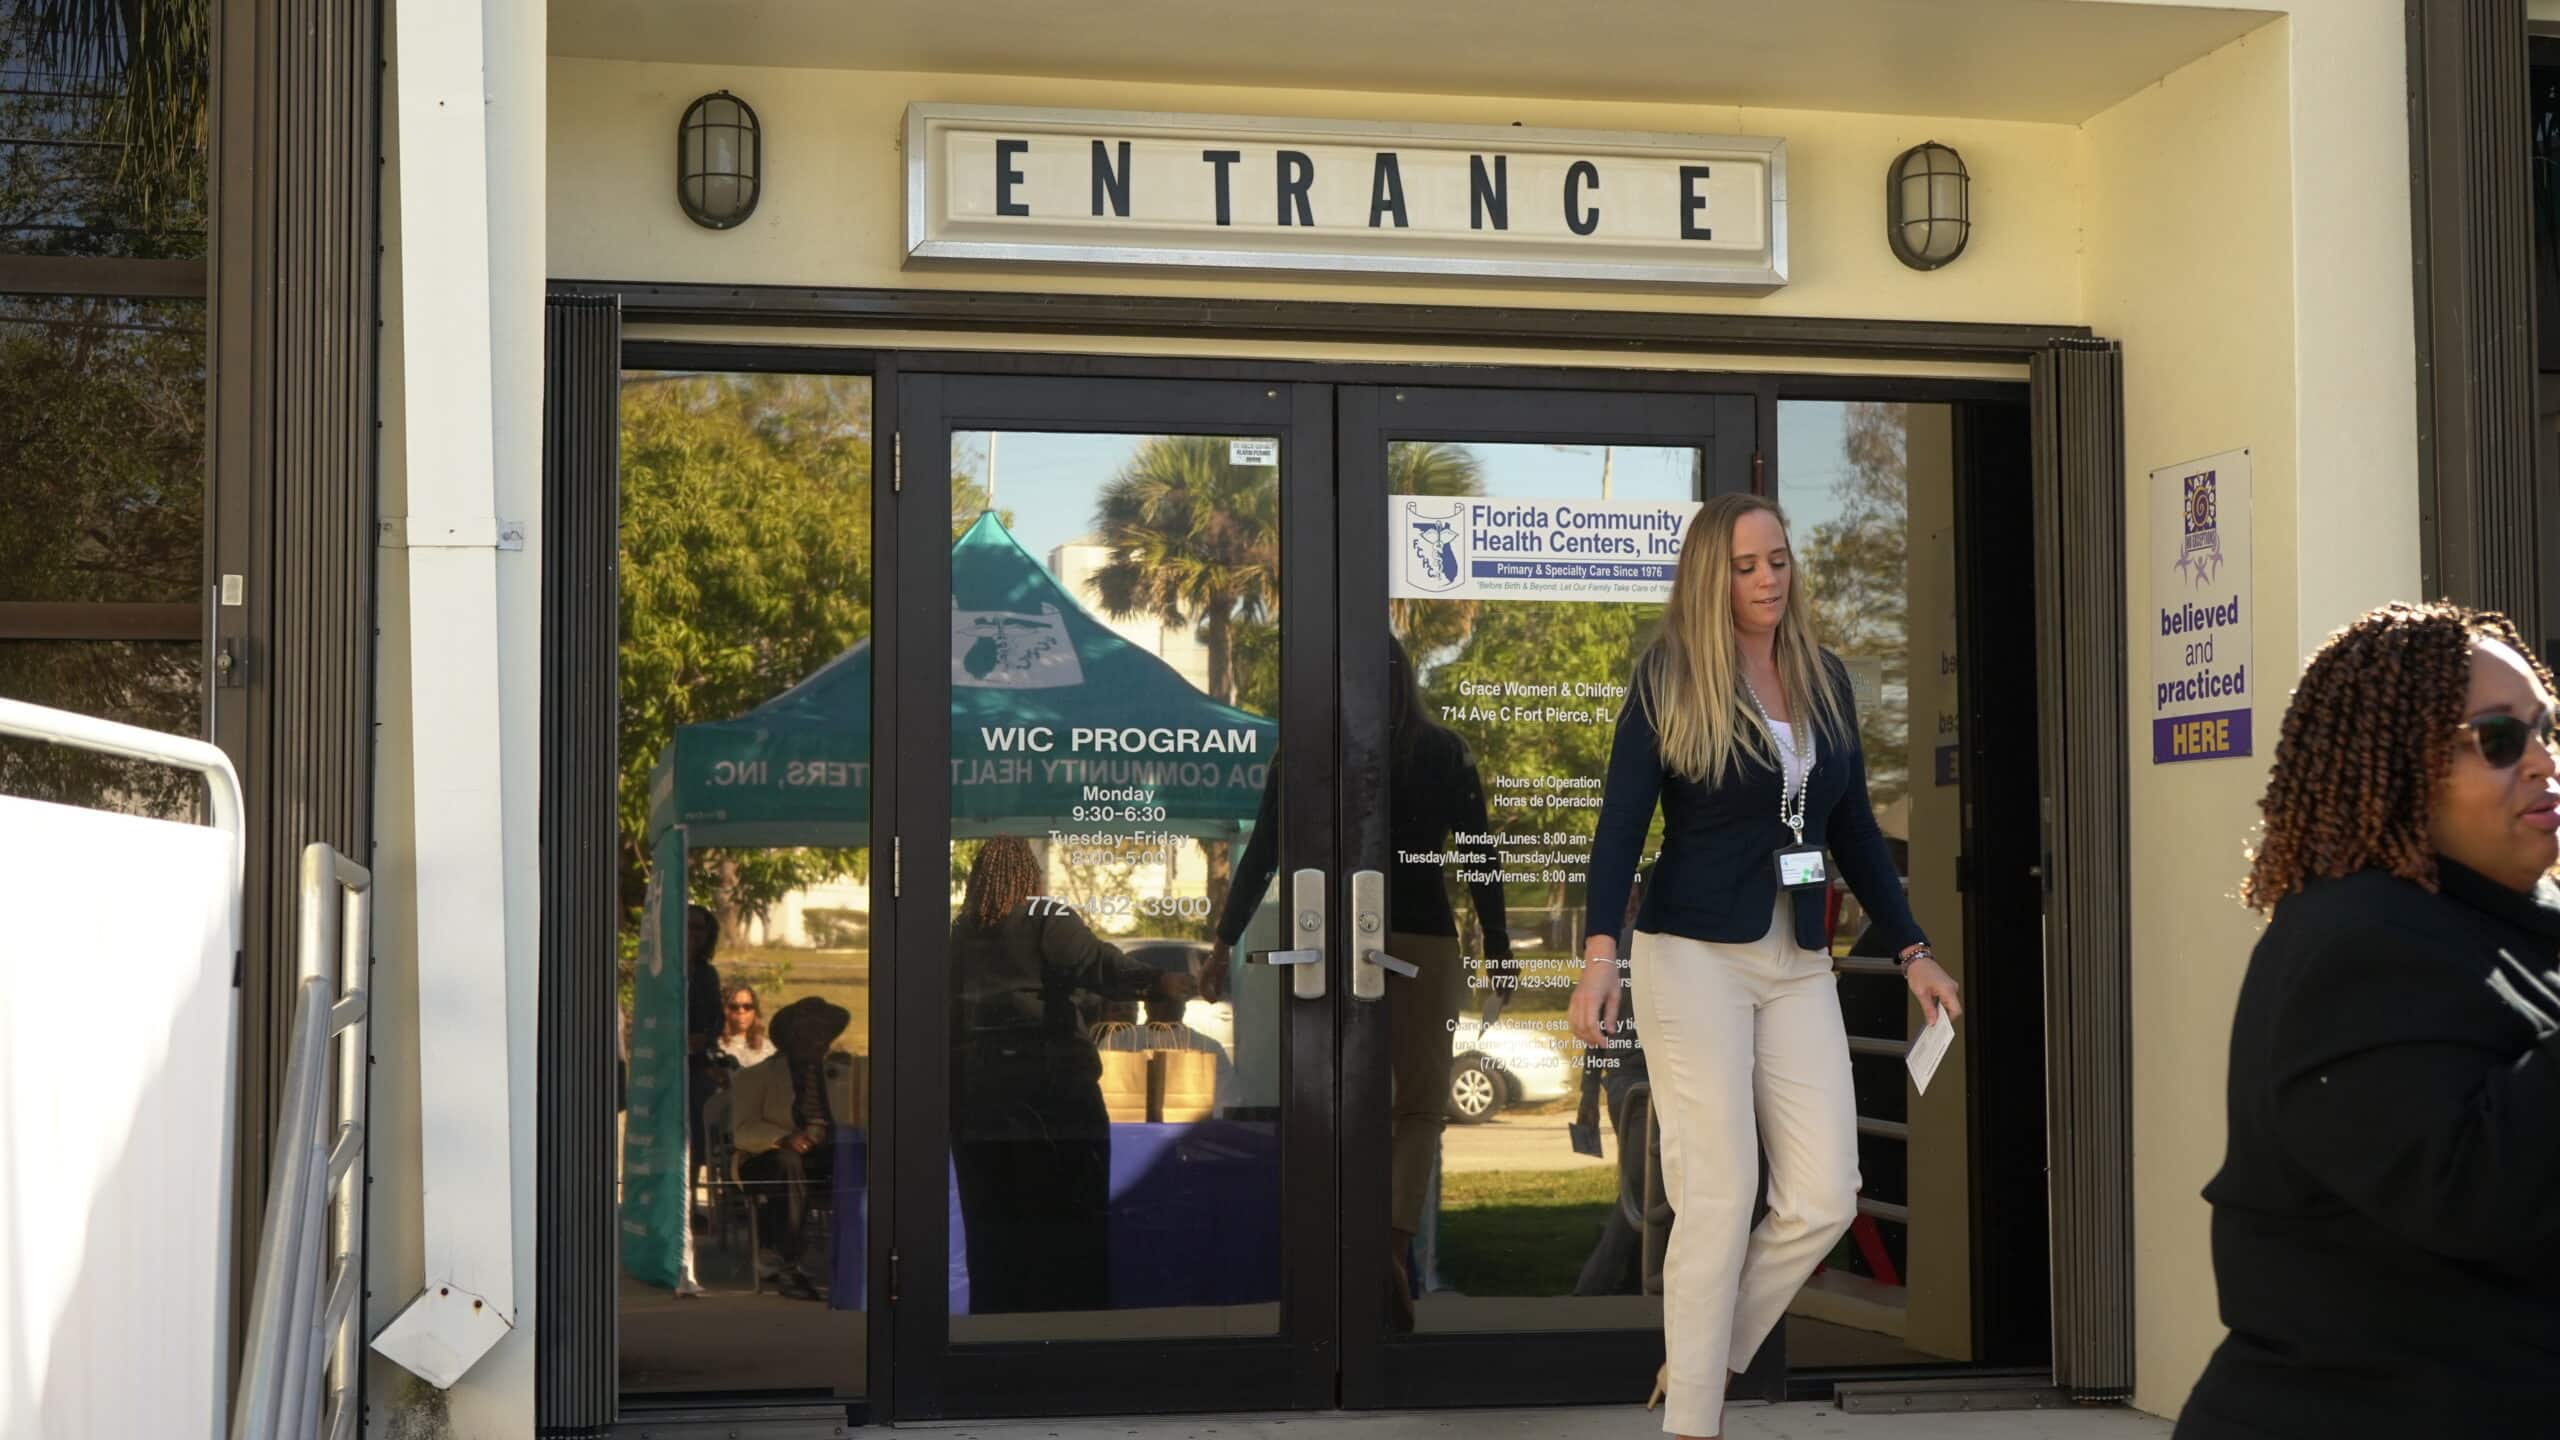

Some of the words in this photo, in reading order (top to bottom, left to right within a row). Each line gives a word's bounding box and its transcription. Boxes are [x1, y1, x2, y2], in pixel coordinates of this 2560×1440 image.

[996, 139, 1712, 241] ENTRANCE
[1472, 505, 1548, 528] Florida
[1556, 507, 1683, 537] Community
[1472, 529, 1542, 552] Health
[1550, 530, 1641, 557] Centers,
[1648, 533, 1680, 554] Inc
[1497, 563, 1533, 577] Primary
[1535, 564, 1542, 575] &
[1545, 564, 1587, 578] Specialty
[1589, 565, 1611, 577] Care
[1613, 565, 1638, 577] Since
[1641, 566, 1662, 577] 1976
[2161, 595, 2239, 636] believed
[2185, 633, 2213, 666] and
[1460, 681, 1500, 696] Grace
[1504, 682, 1557, 697] Women
[1561, 682, 1571, 697] &
[2158, 664, 2244, 711] practiced
[1441, 706, 1466, 721] 714
[1469, 706, 1496, 721] Ave
[1500, 707, 1511, 721] C
[1514, 707, 1542, 722] Fort
[1546, 707, 1592, 724] Pierce,
[1596, 708, 1614, 722] FL
[981, 727, 1054, 752] WIC
[1072, 727, 1257, 753] PROGRAM
[2172, 719, 2230, 756] HERE
[1496, 776, 1530, 788] Hours
[1532, 776, 1545, 788] of
[1546, 776, 1600, 791] Operation
[1083, 786, 1154, 804] Monday
[1494, 795, 1527, 807] Horas
[1530, 795, 1544, 807] de
[1546, 795, 1603, 810] Operacion
[1072, 806, 1166, 822] 9:30-6:30
[1048, 830, 1190, 848] Tuesday-Friday
[1455, 832, 1540, 847] Monday/Lunes:
[1543, 832, 1567, 845] 8:00
[1569, 835, 1587, 845] am
[1398, 851, 1486, 865] Tuesday/Martes
[1456, 870, 1540, 885] Friday/Viernes:
[1542, 870, 1566, 883] 8:00
[1568, 873, 1586, 883] am
[1463, 957, 1482, 969] For
[1485, 960, 1499, 969] an
[1501, 960, 1563, 971] emergency
[1467, 976, 1489, 988] Call
[1491, 976, 1519, 990] (772)
[1521, 976, 1570, 988] 429-3400
[1605, 1036, 1632, 1049] lame
[1587, 1056, 1621, 1069] Horas
